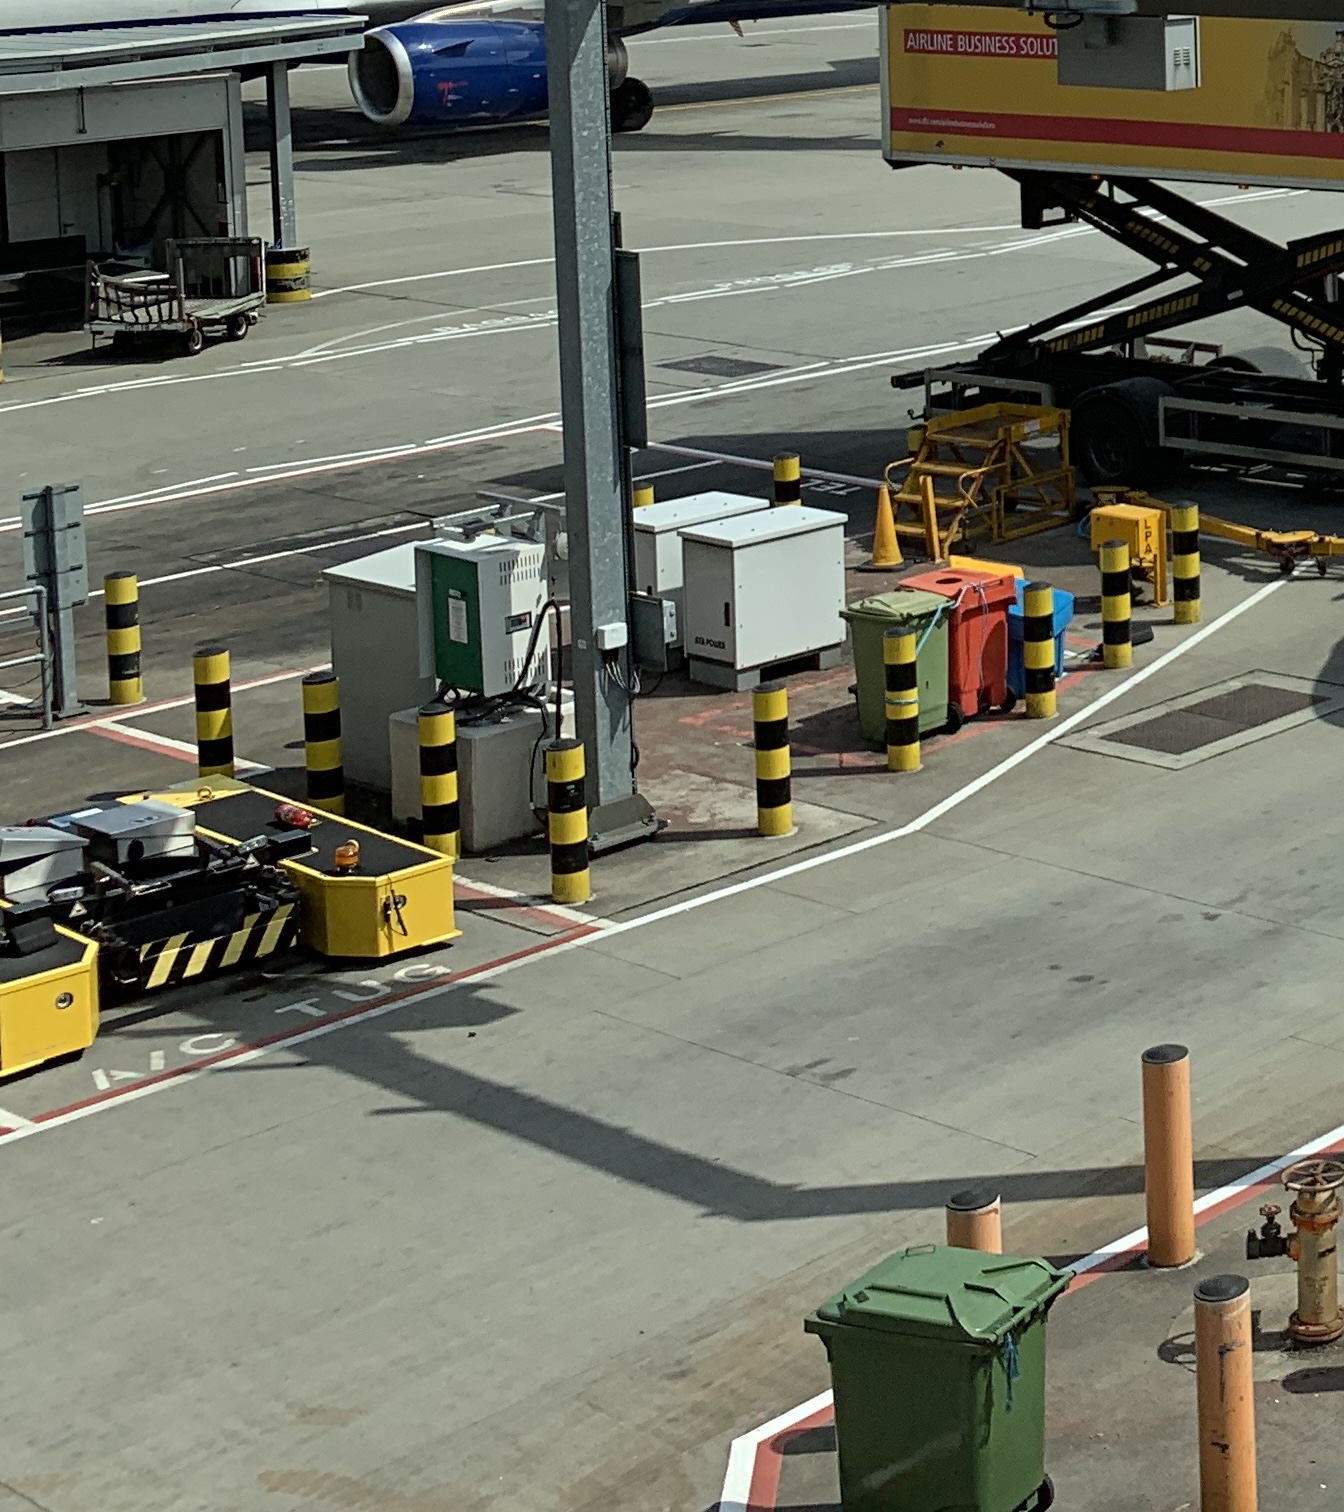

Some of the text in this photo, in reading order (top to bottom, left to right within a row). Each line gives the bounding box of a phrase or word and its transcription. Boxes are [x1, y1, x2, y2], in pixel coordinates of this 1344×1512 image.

[906, 32, 953, 51] AIRLINE
[957, 35, 1017, 55] BUSINESS
[1144, 519, 1152, 555] LPA
[92, 963, 452, 1090] A/C TUG
